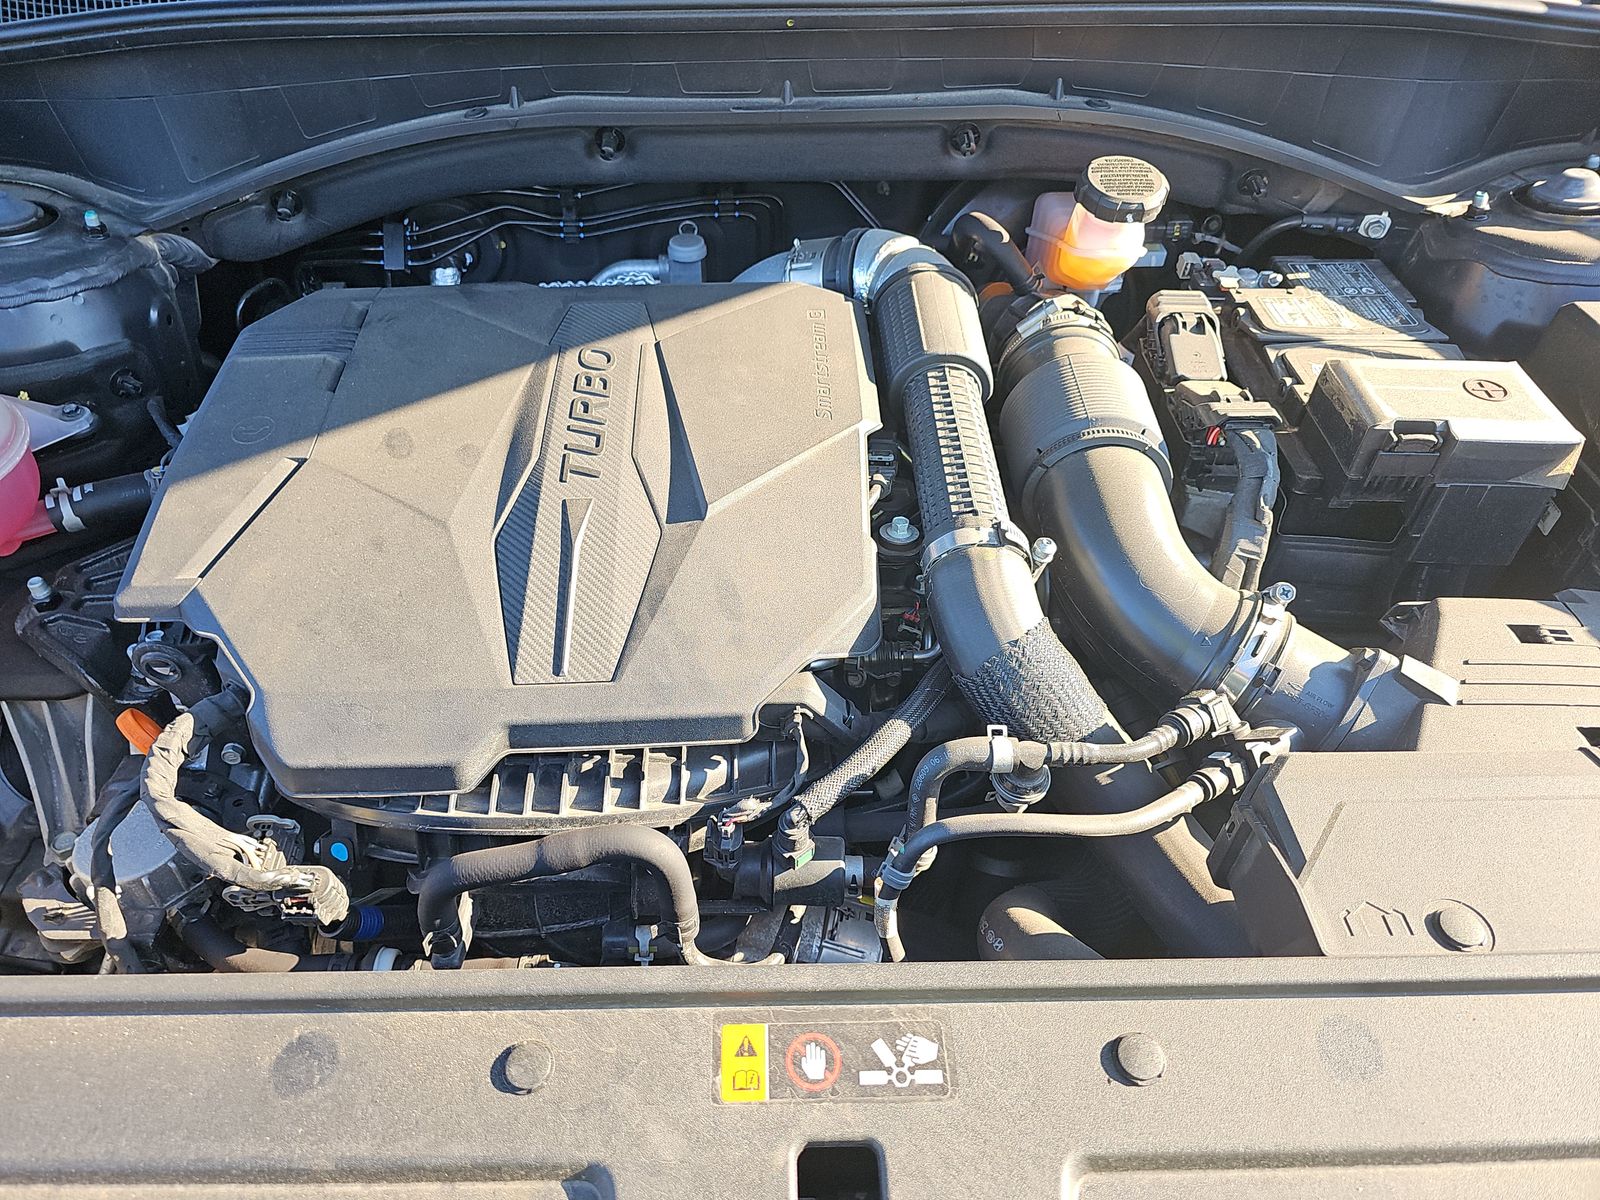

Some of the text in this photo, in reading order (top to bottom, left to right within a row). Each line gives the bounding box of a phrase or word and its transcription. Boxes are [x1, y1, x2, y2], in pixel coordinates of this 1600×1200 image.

[559, 347, 616, 483] TURBO
[812, 322, 833, 420] Smartstream
[1316, 696, 1335, 709] FLOW
